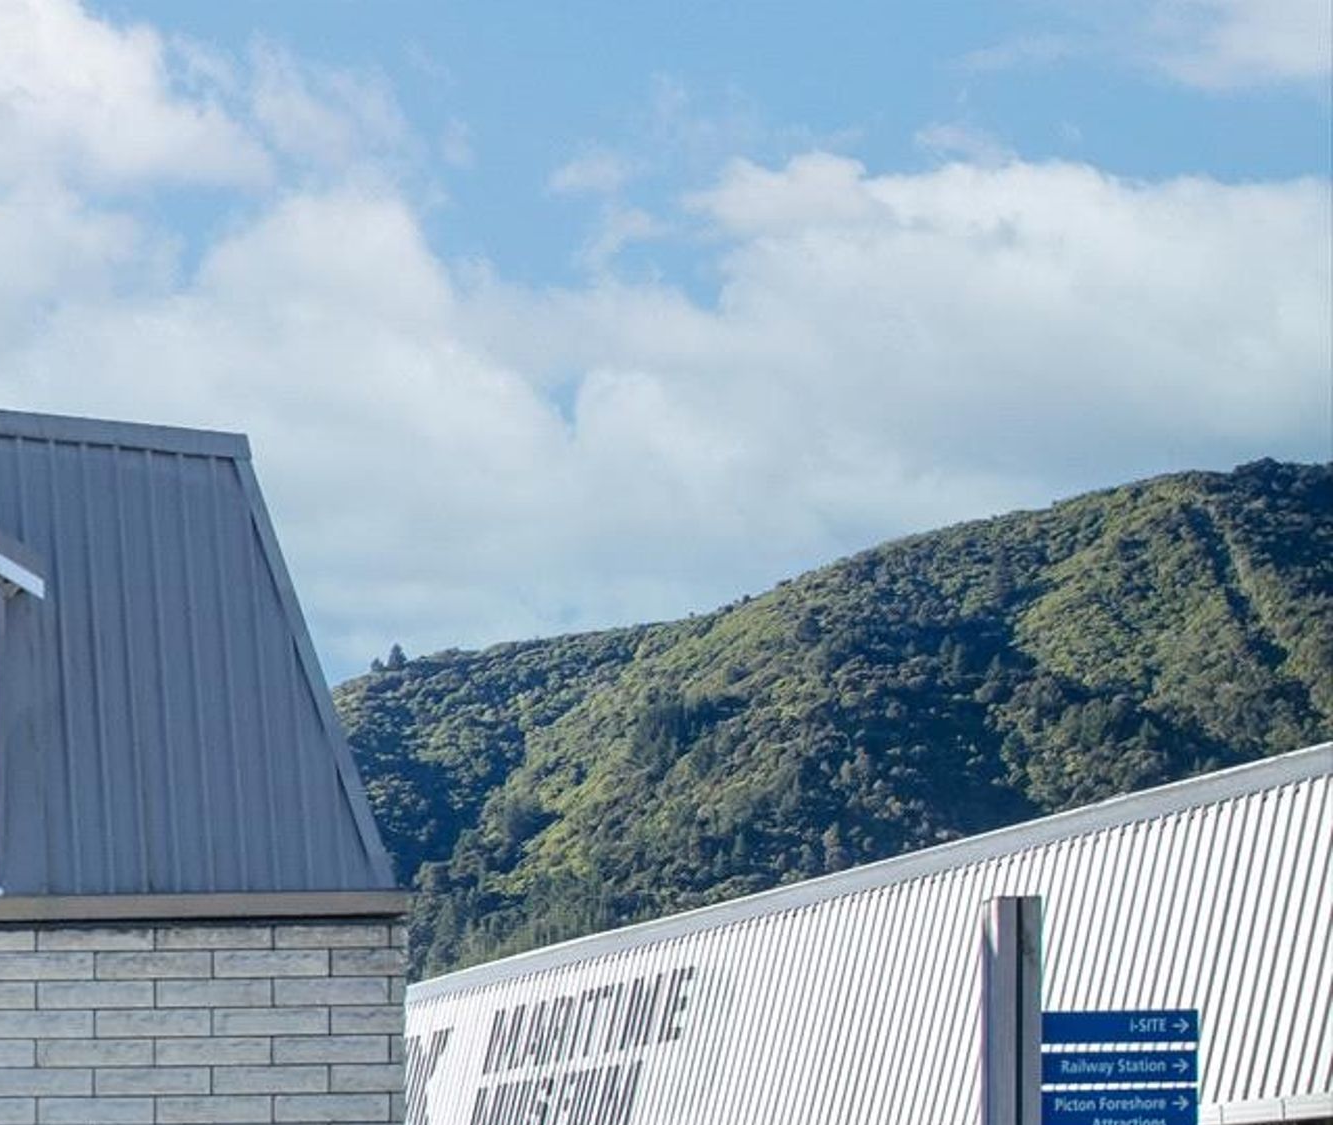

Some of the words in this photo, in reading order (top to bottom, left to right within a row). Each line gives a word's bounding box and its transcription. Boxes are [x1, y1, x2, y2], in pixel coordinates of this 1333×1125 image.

[483, 967, 695, 1075] MARITIME
[1061, 1060, 1113, 1077] Railway
[1118, 1058, 1166, 1073] Station
[1055, 1098, 1096, 1111] Picton
[1099, 1098, 1166, 1110] Foreshore
